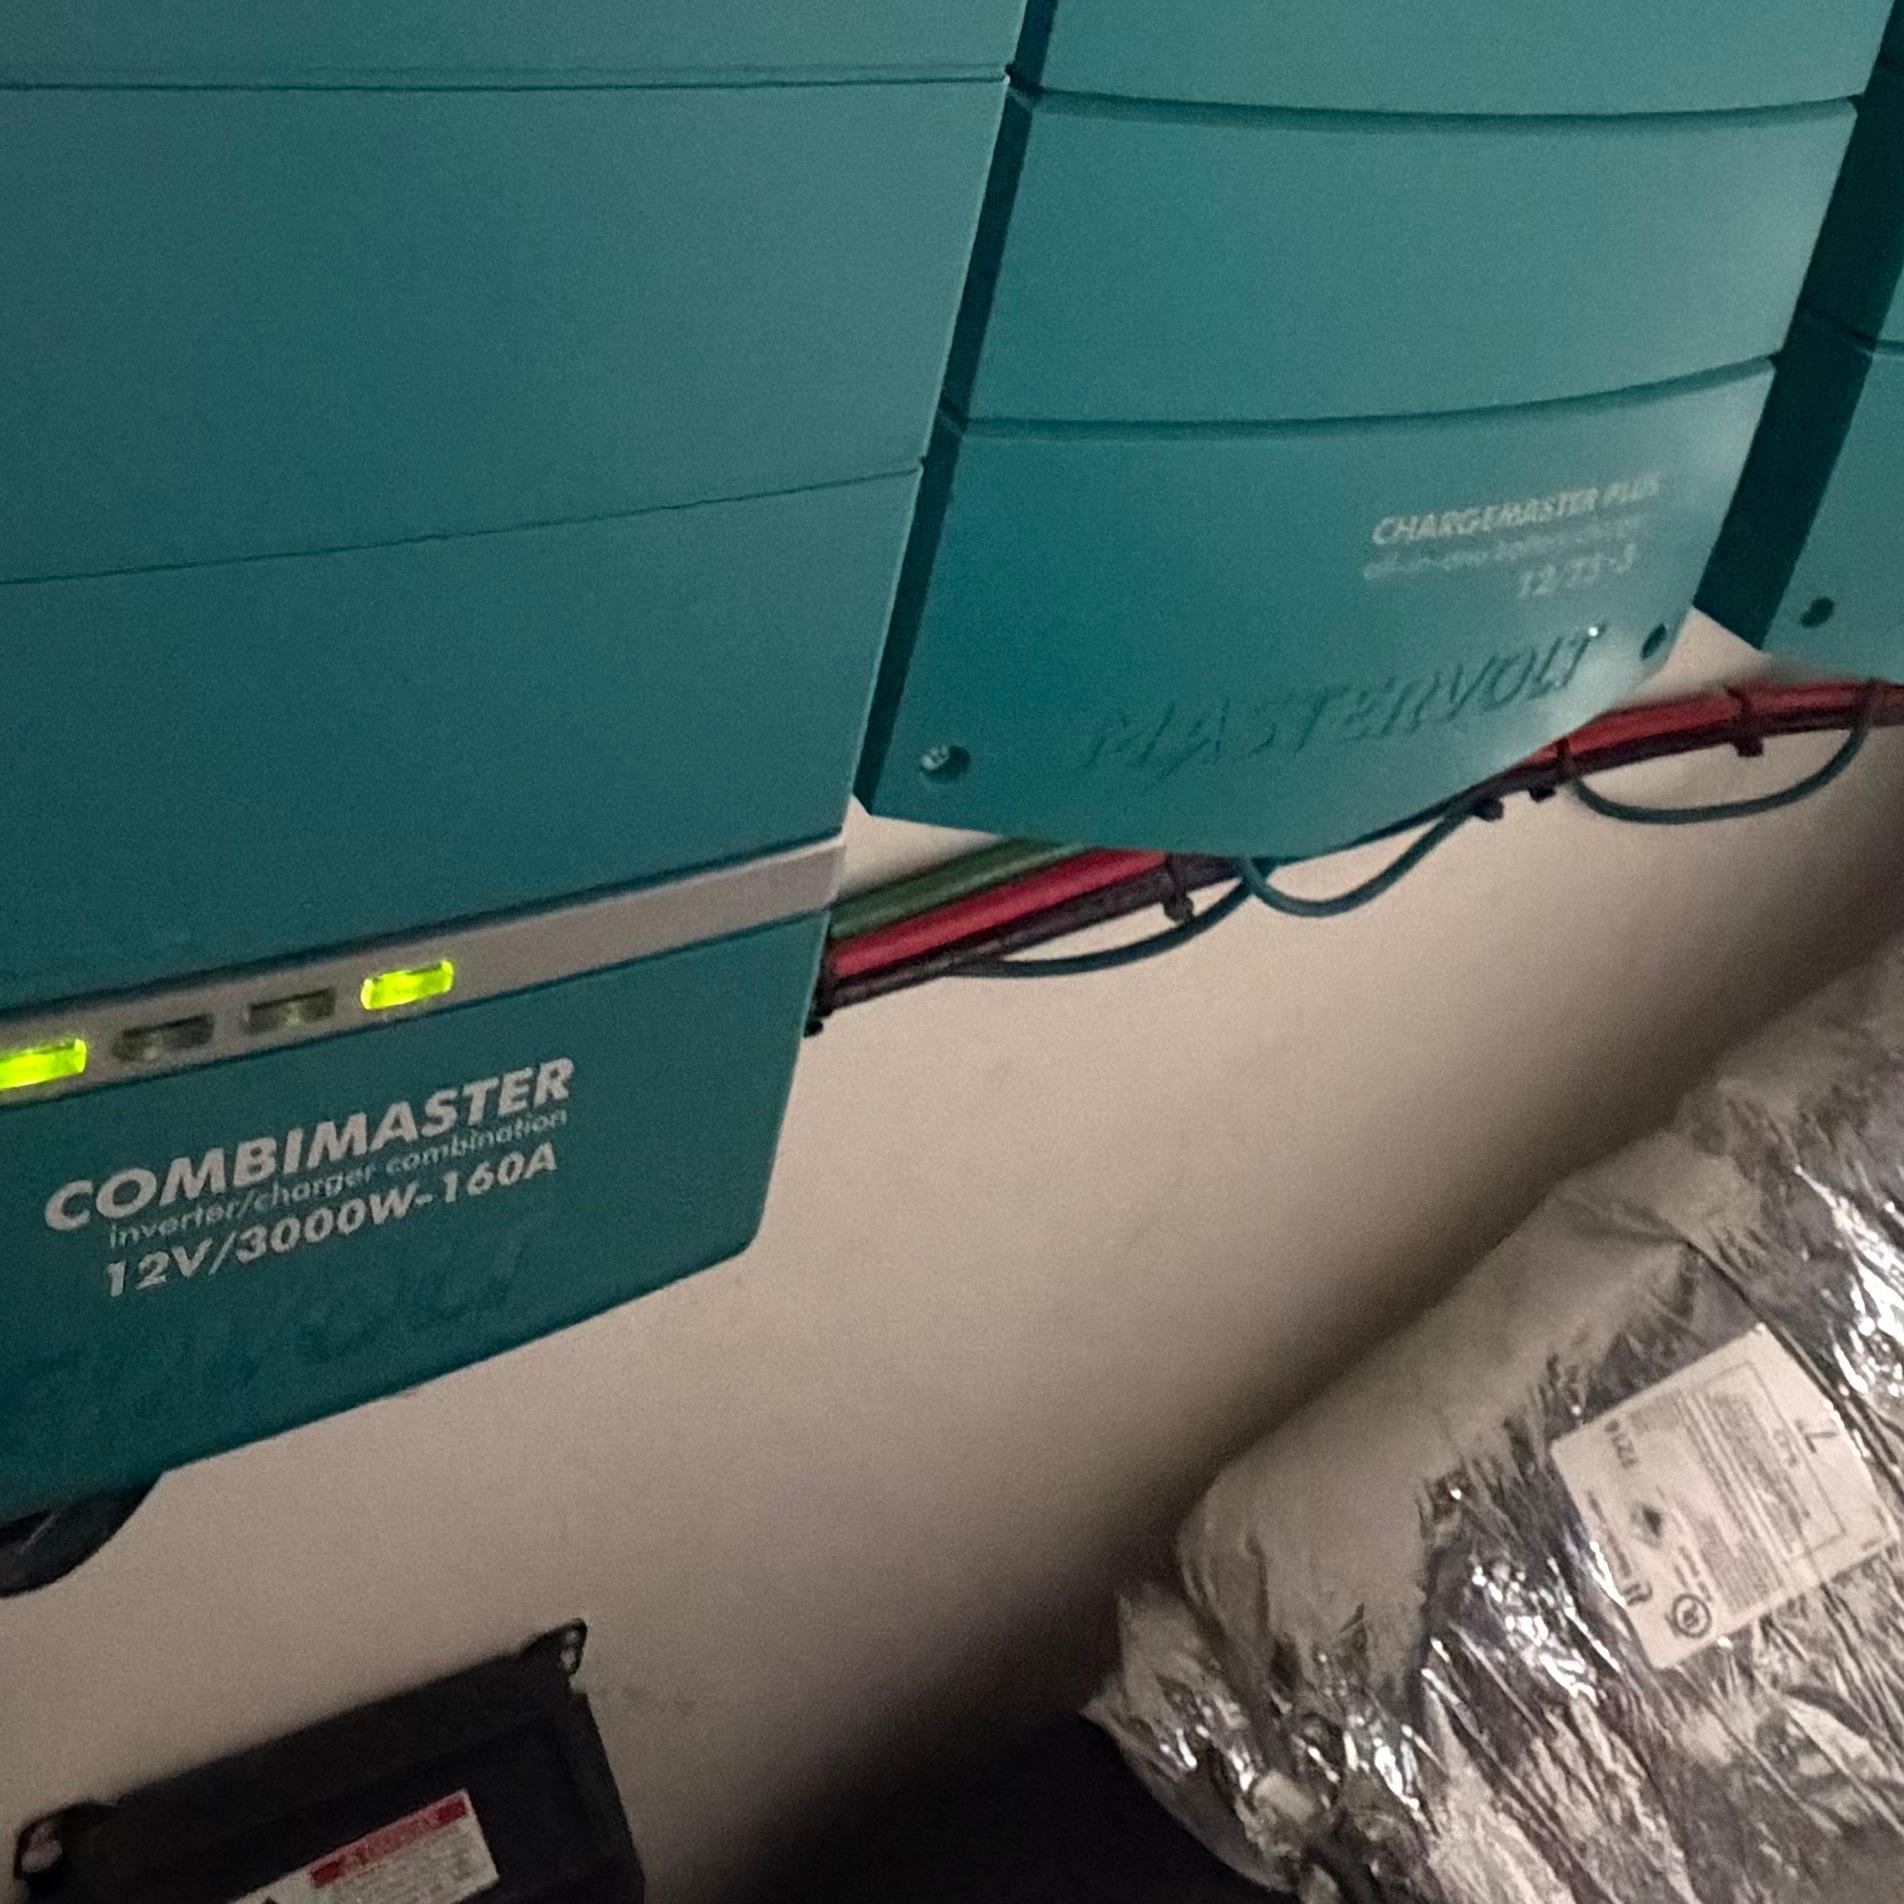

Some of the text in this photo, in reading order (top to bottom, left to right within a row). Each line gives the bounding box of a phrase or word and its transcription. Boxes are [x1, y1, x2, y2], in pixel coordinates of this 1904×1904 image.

[1372, 488, 1598, 545] CHARGEMASTER
[1080, 618, 1608, 786] MASTERVOLT
[44, 1057, 575, 1232] COMBIMASTER
[105, 1142, 558, 1297] 12V/3000W-160A
[110, 1109, 568, 1250] inverter/charger combination
